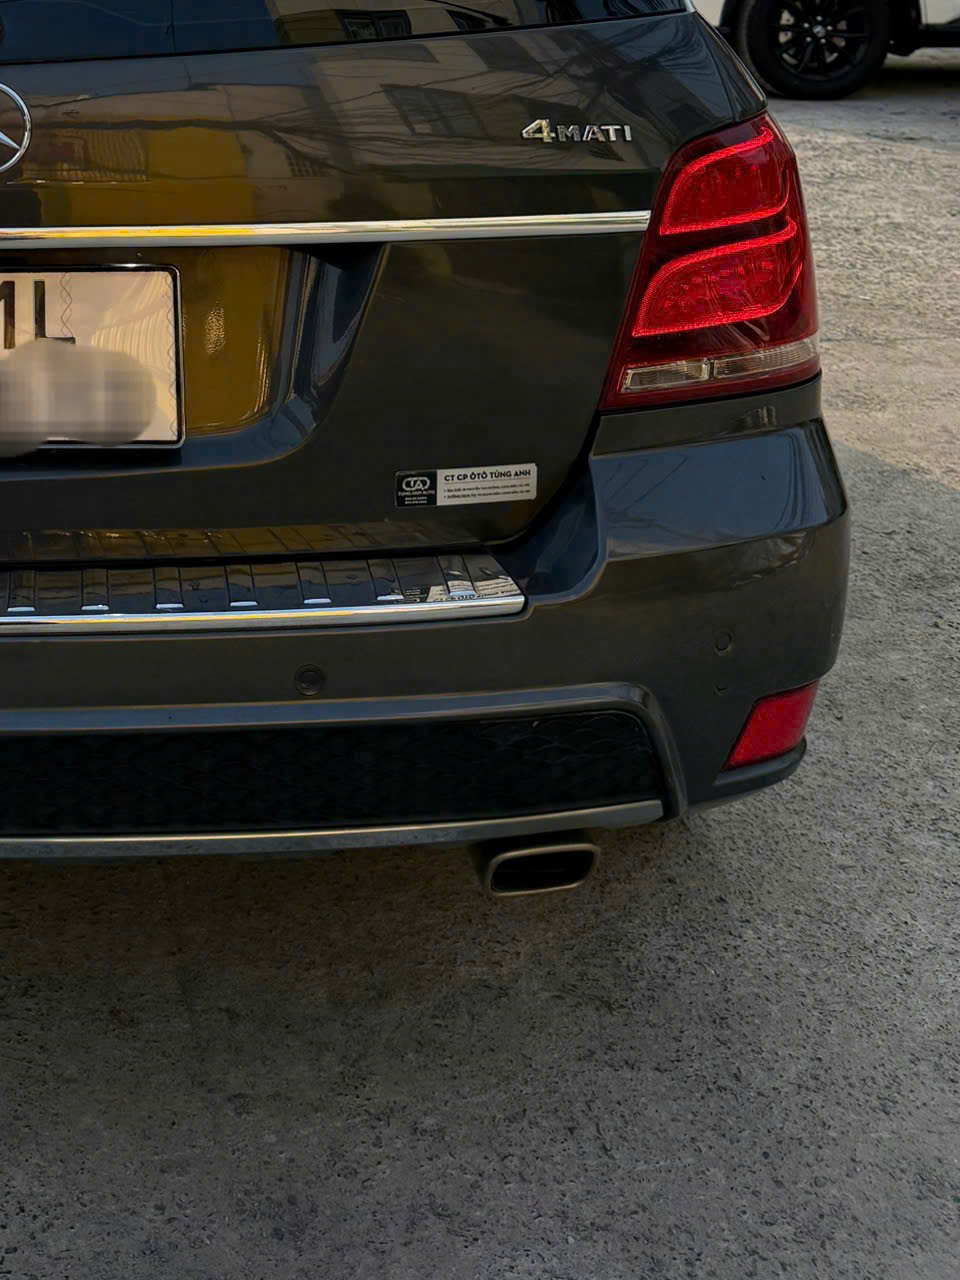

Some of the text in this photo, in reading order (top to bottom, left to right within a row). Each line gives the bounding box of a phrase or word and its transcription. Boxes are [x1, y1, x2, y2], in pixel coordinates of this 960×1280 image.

[521, 119, 632, 142] 4MATI
[444, 474, 456, 482] CT
[457, 473, 468, 481] CP
[513, 469, 531, 477] ANH
